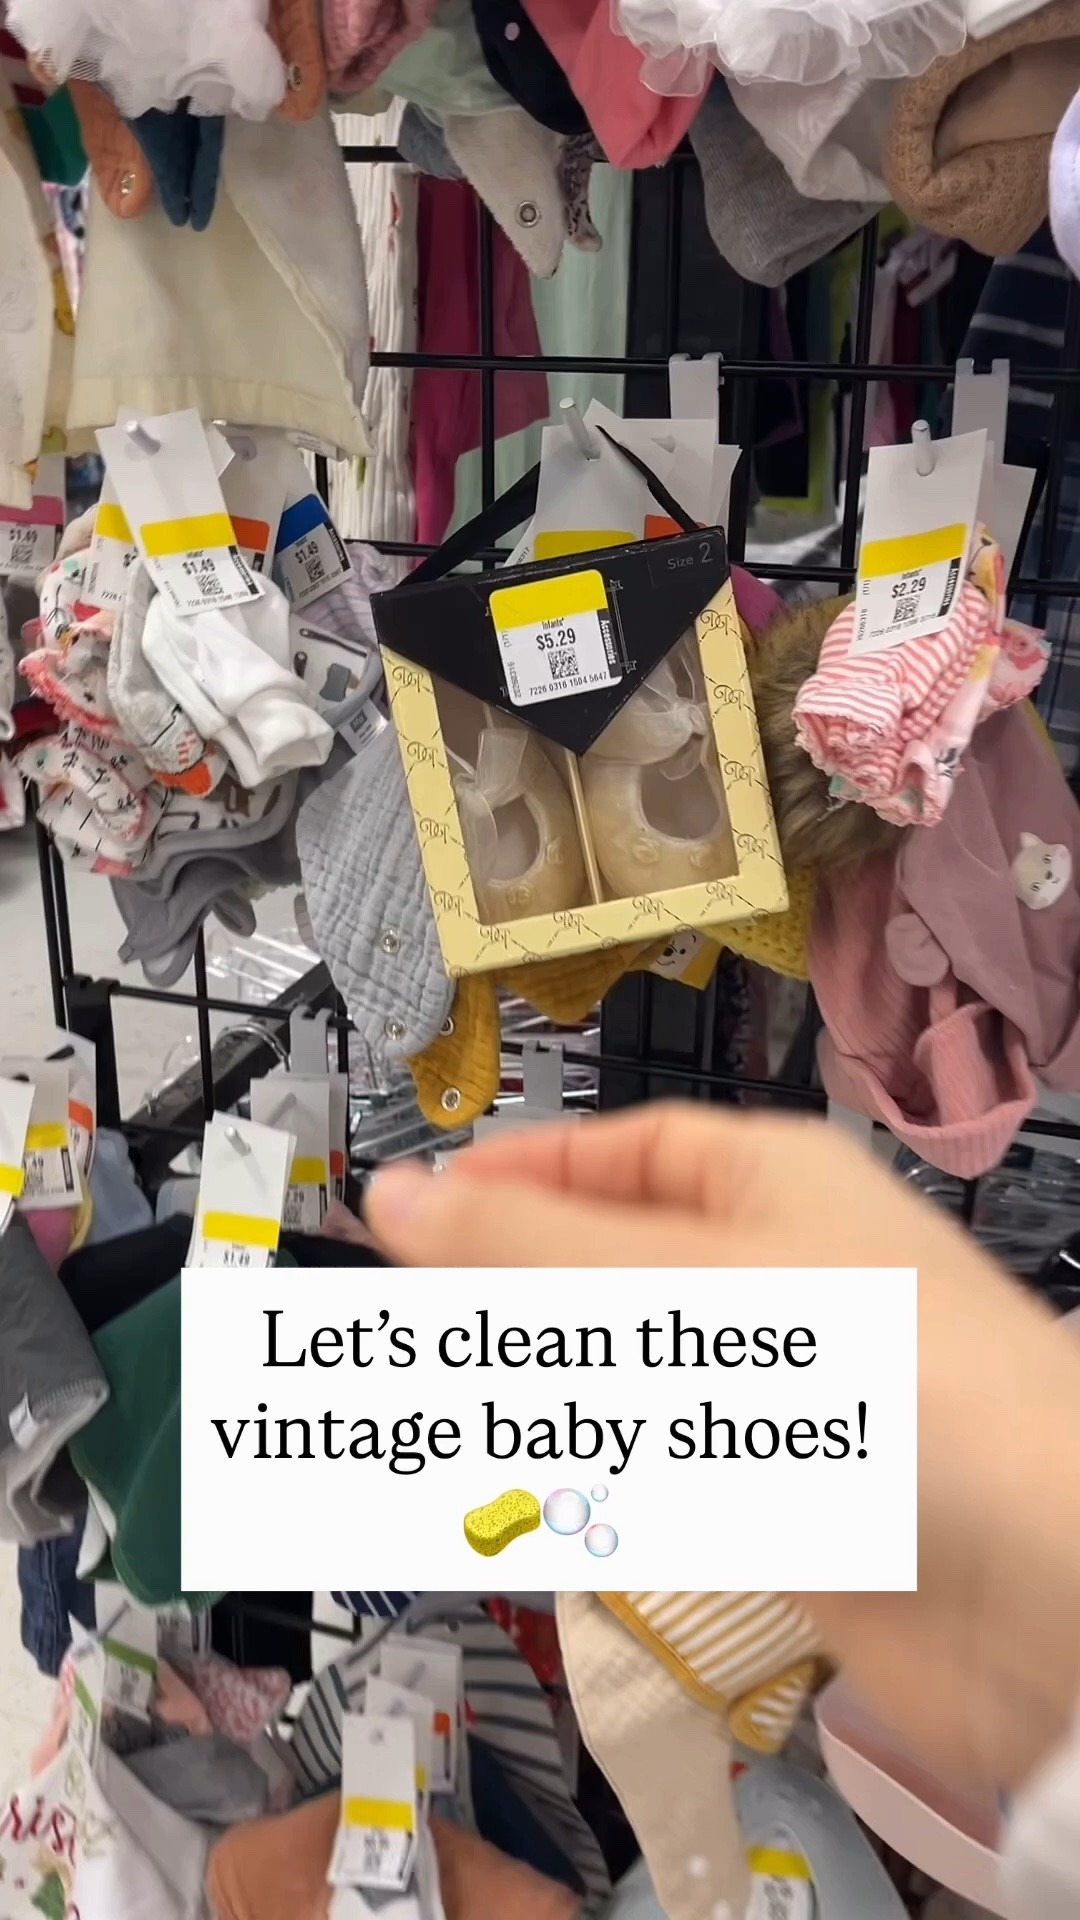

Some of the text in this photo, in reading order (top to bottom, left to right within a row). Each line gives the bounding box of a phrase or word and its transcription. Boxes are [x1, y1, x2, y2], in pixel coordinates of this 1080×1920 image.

[182, 557, 216, 576] $1.49
[667, 541, 714, 570] Size 2
[891, 577, 926, 599] $2.29
[536, 628, 576, 651] $5.29
[600, 619, 617, 665] Accessories
[529, 685, 548, 697] 7226
[548, 680, 568, 692] 0316
[588, 671, 608, 684] 5647
